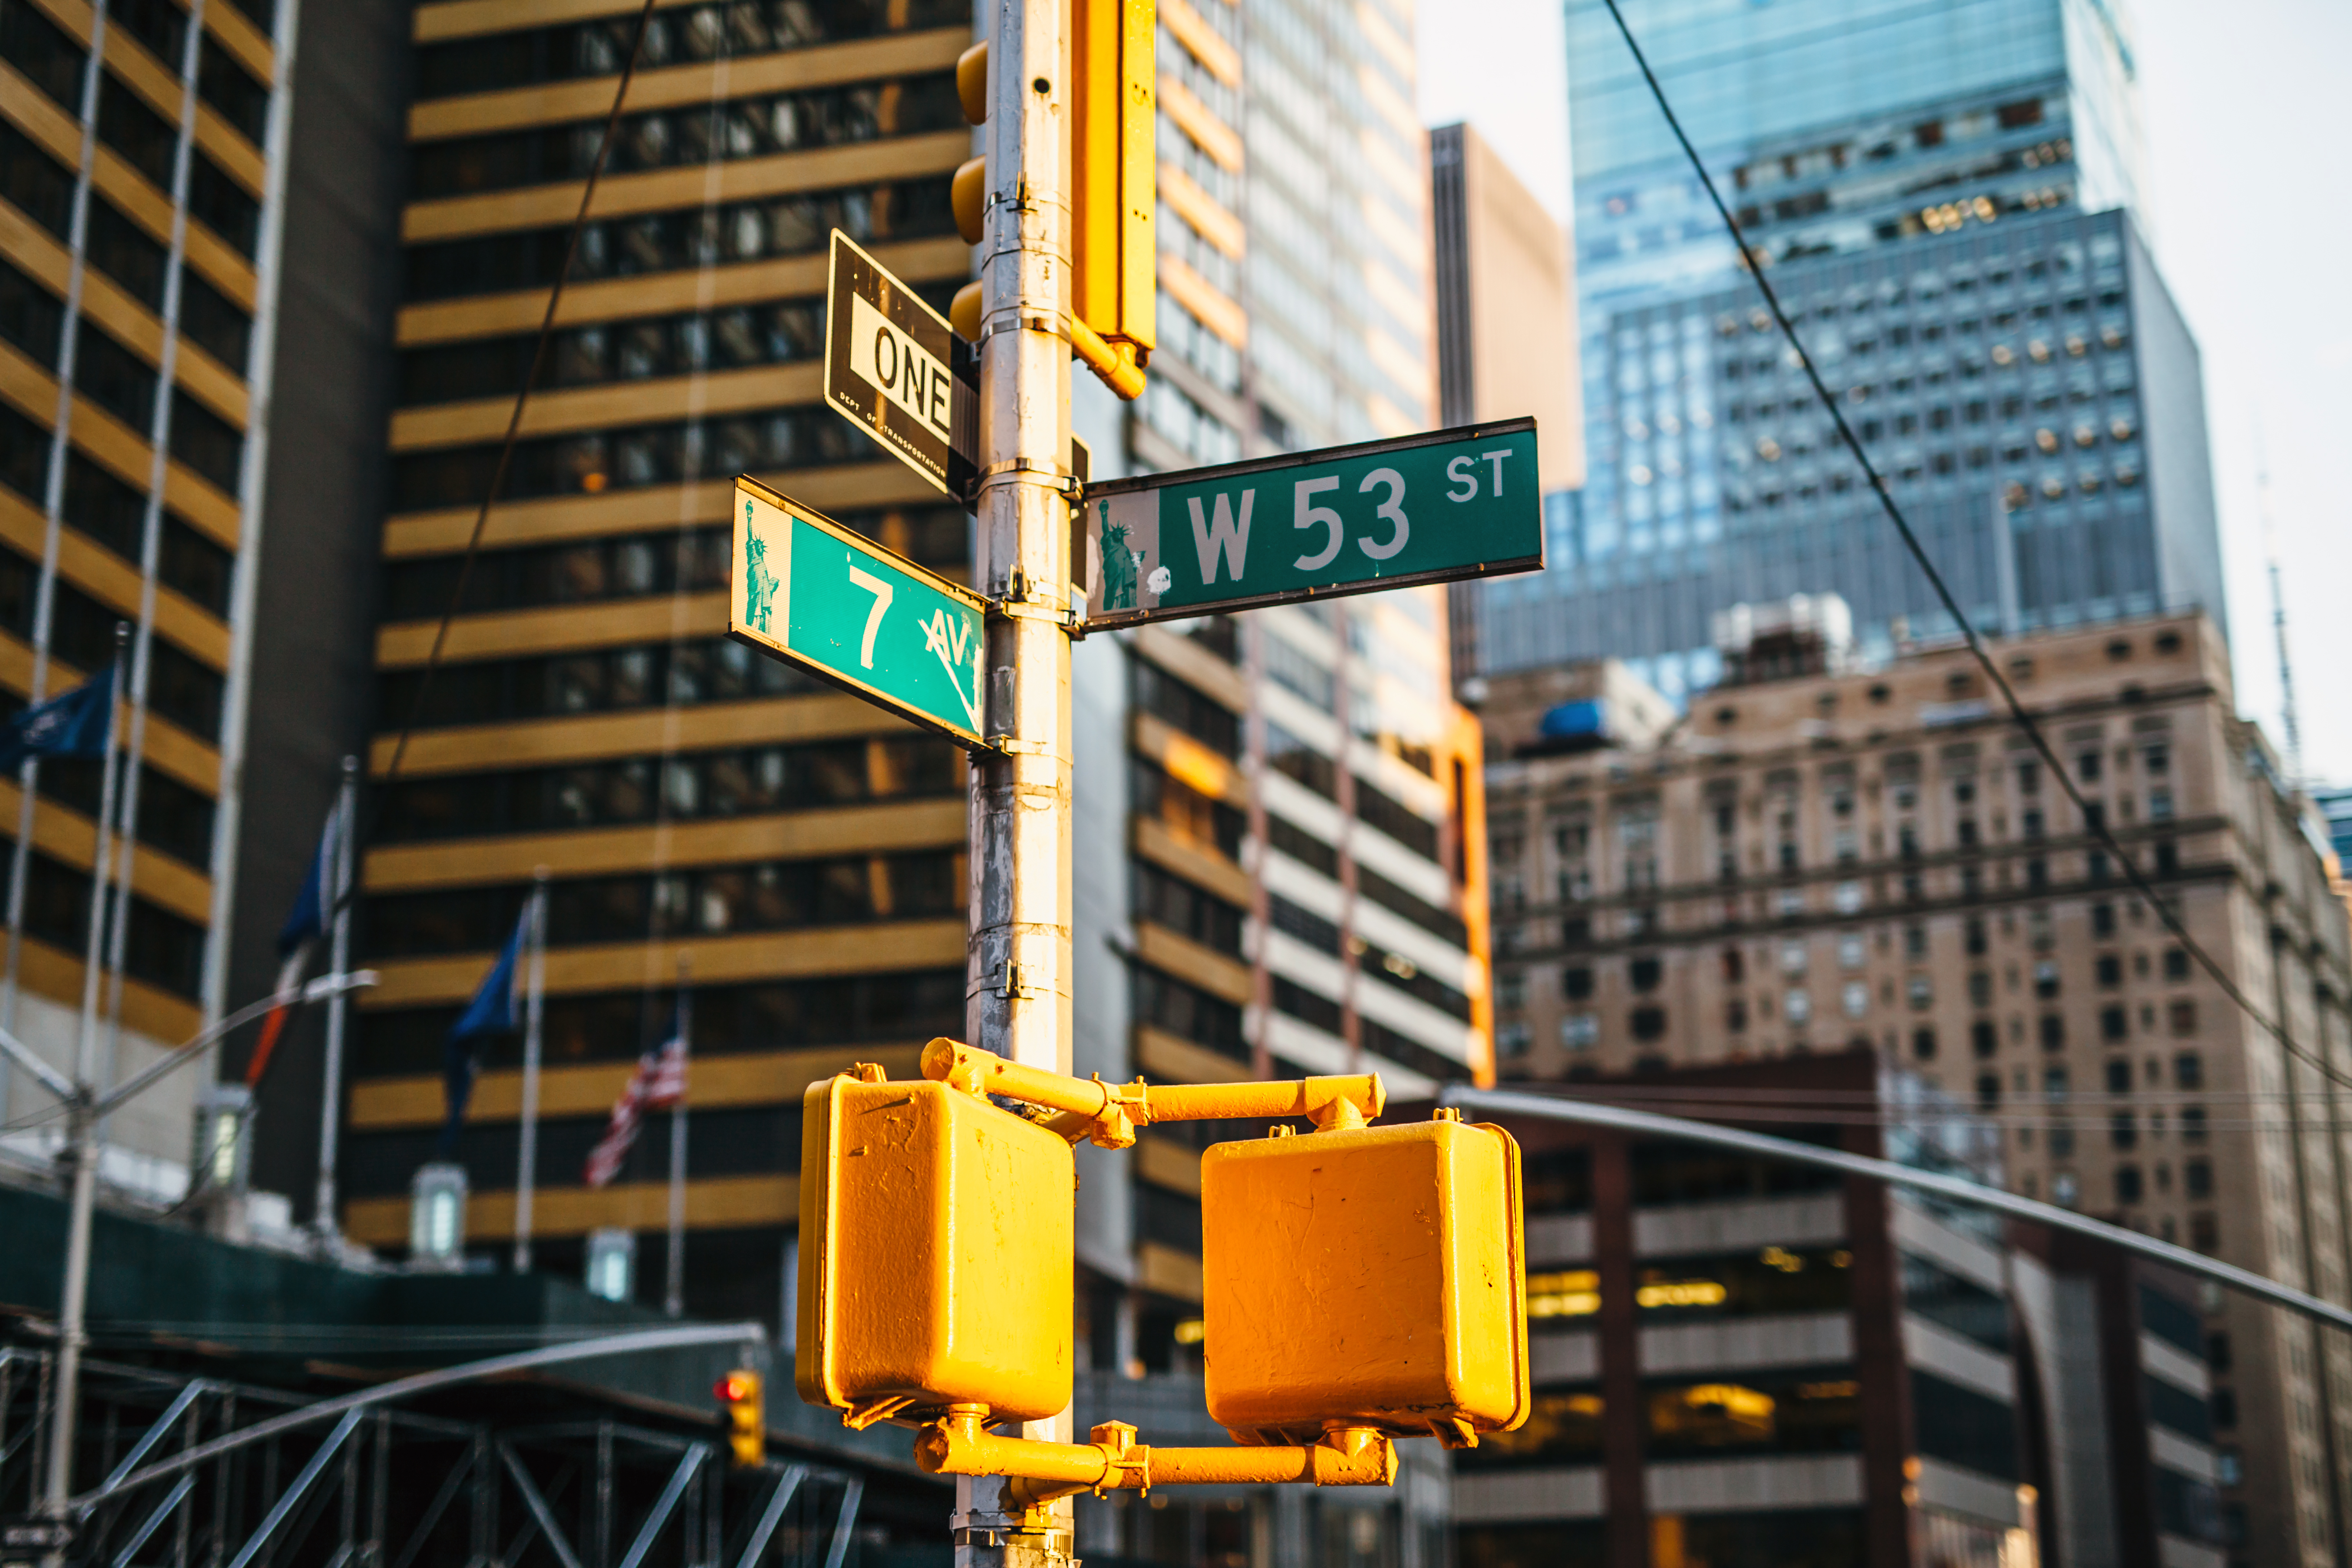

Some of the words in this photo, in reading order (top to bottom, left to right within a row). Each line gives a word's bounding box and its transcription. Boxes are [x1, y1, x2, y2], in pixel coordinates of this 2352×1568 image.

[875, 326, 951, 430] ONE
[840, 391, 860, 411] DEPT
[867, 412, 877, 423] OF
[884, 425, 946, 478] TRANSPORTATION
[1187, 489, 1255, 585] W
[1293, 468, 1410, 571] 53
[1446, 449, 1512, 503] ST
[850, 565, 893, 670] 7
[925, 608, 970, 666] AV
